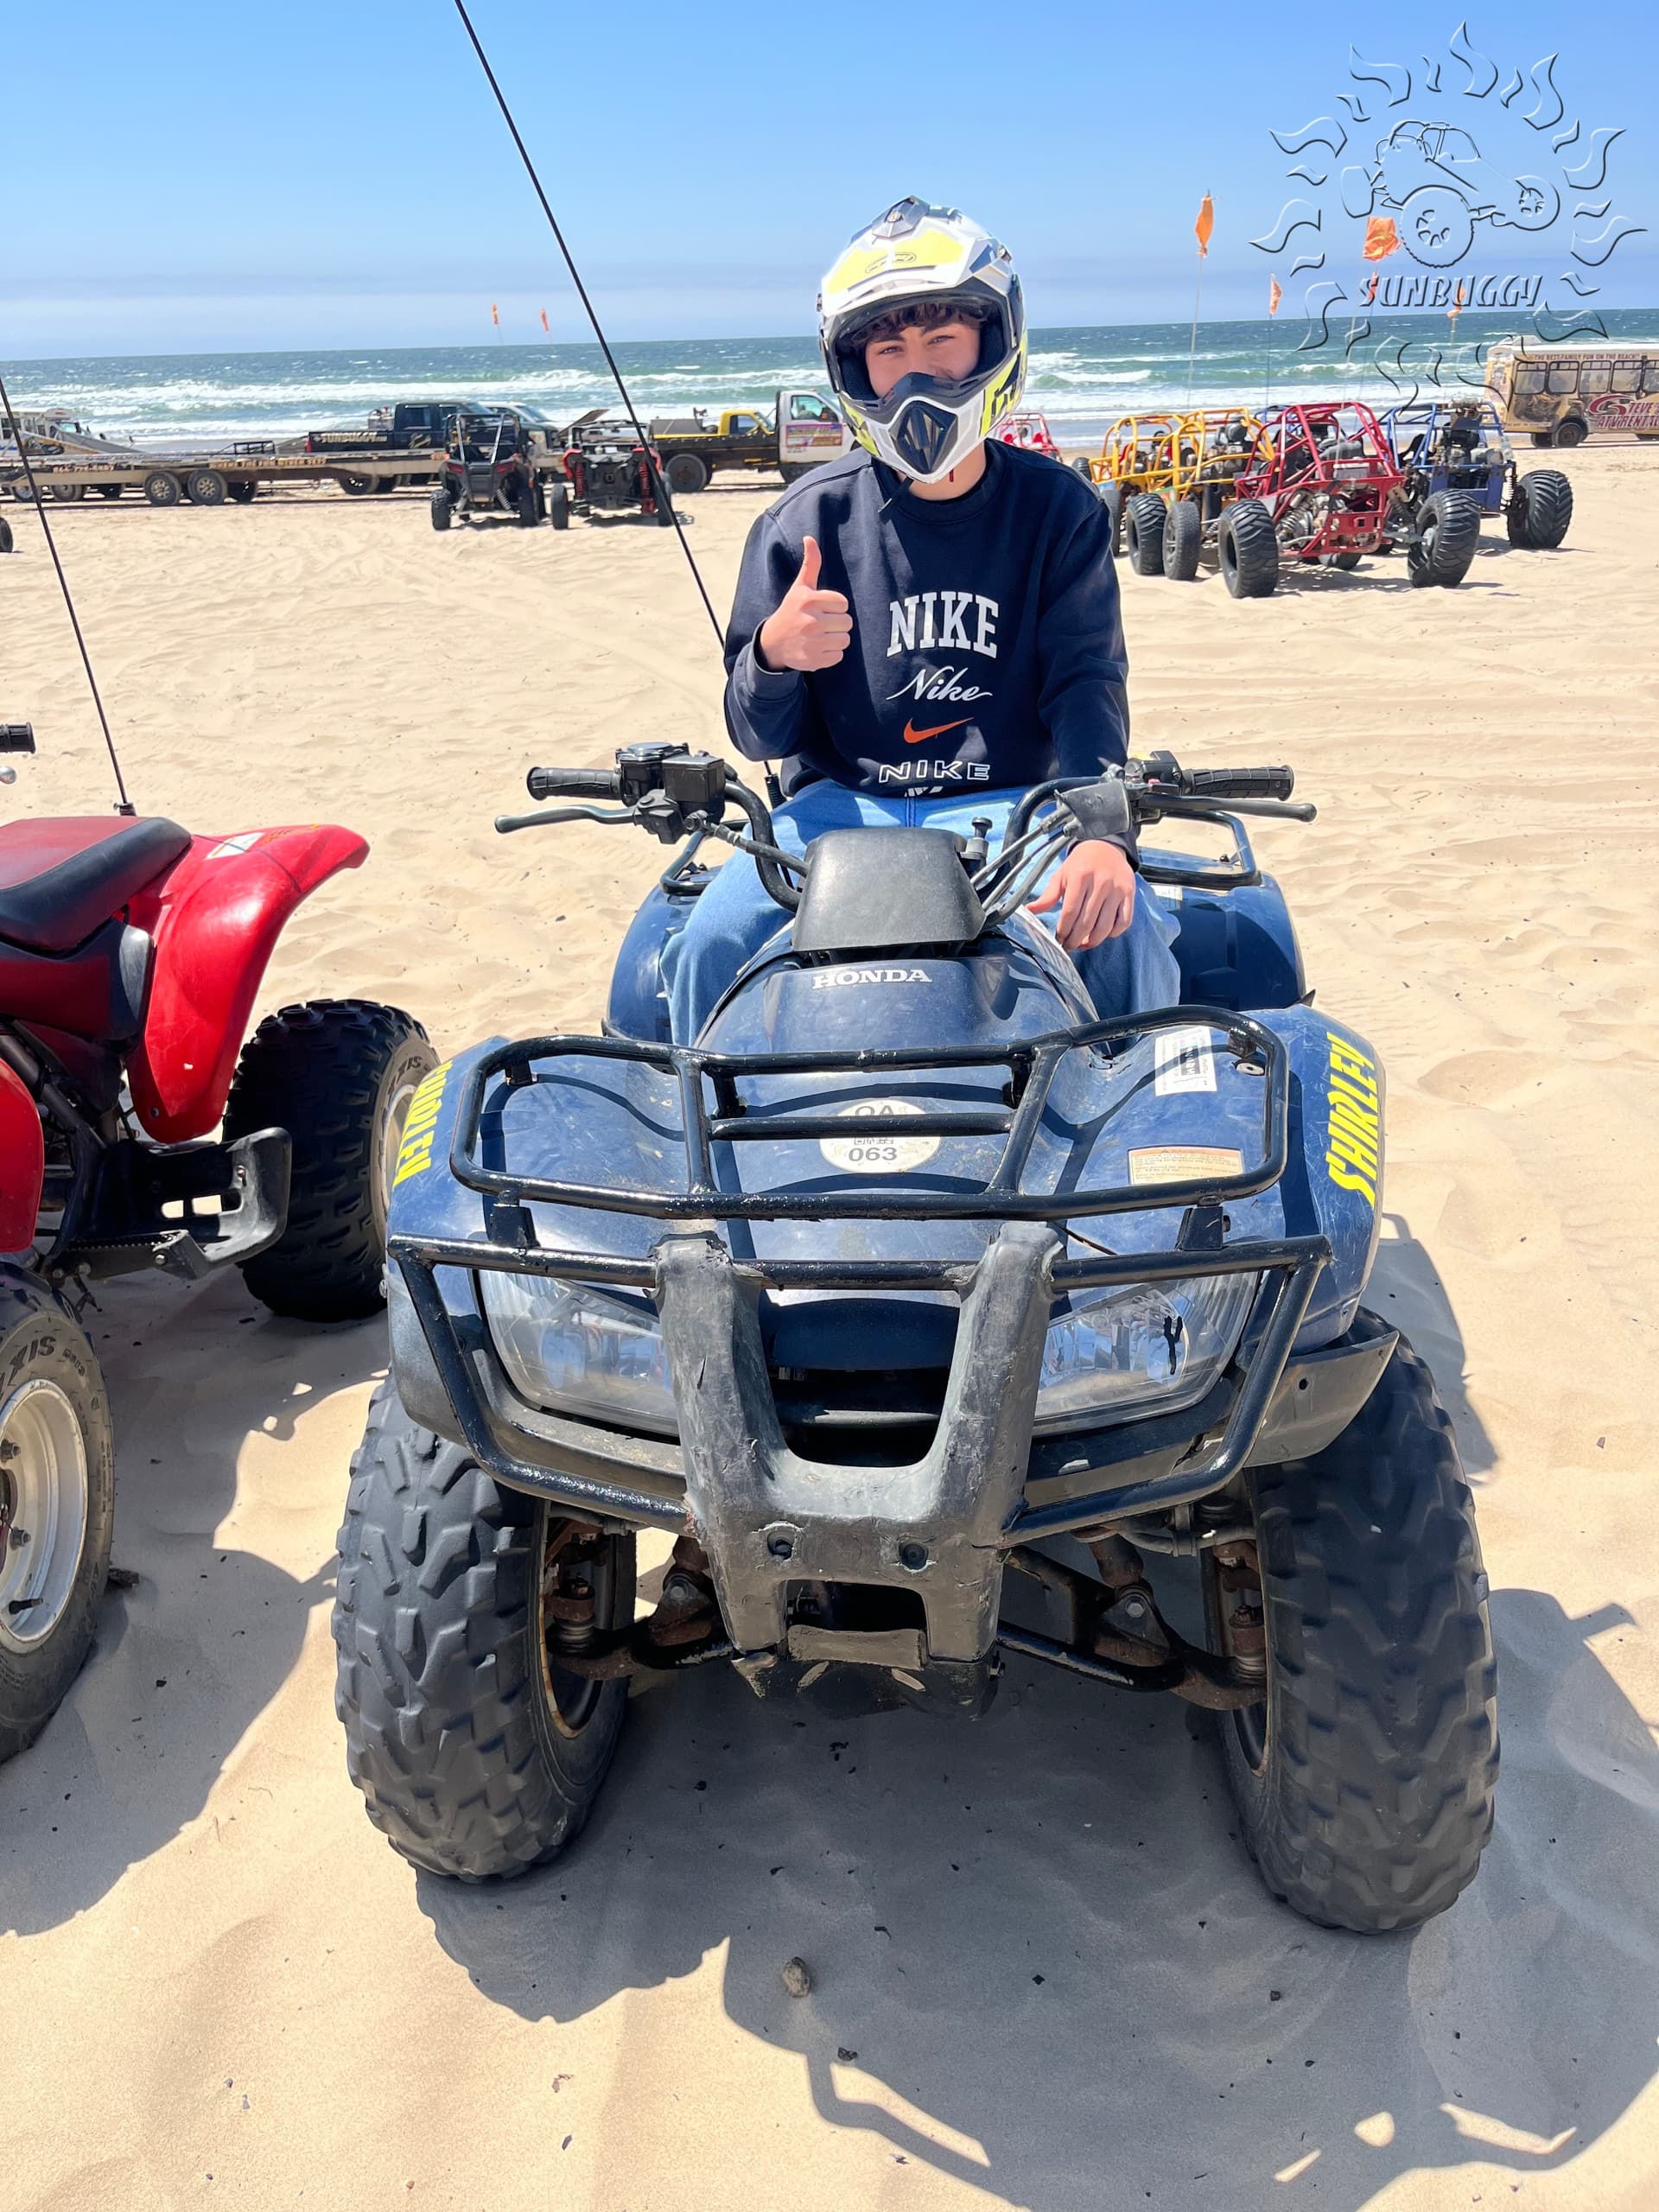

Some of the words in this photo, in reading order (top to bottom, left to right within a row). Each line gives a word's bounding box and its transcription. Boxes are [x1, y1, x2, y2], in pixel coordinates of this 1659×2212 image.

[887, 591, 999, 658] NIKE
[886, 665, 993, 702] Nike
[879, 760, 990, 783] NIKE
[812, 969, 932, 989] HONDA
[1325, 1032, 1378, 1208] SHIRLEY
[849, 1147, 897, 1161] 063
